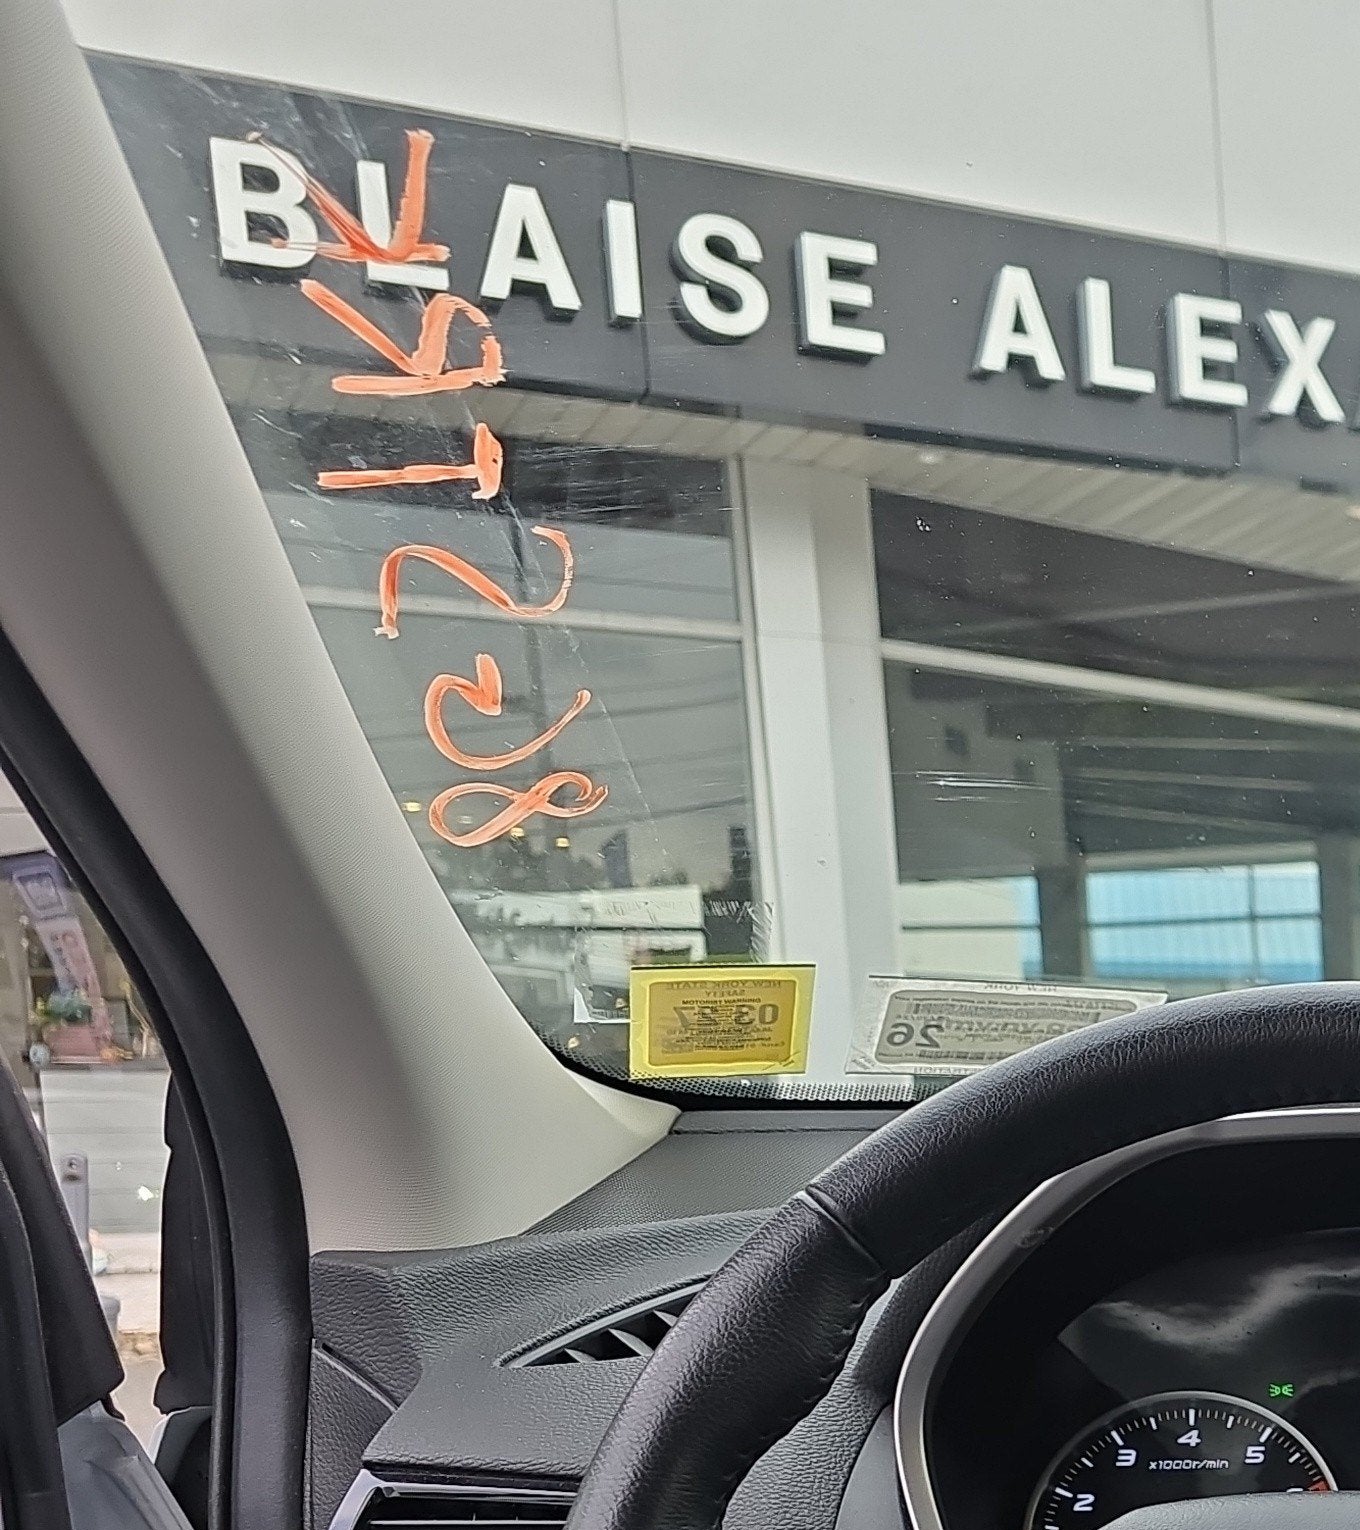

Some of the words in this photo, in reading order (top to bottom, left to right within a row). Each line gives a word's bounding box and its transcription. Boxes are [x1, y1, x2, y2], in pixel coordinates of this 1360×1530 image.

[209, 136, 886, 356] BLAISE
[1177, 1429, 1201, 1447] 4
[1116, 1449, 1137, 1467] 3
[1245, 1445, 1266, 1463] 5
[1148, 1459, 1229, 1470] x1000r/min
[1073, 1493, 1095, 1512] 2
